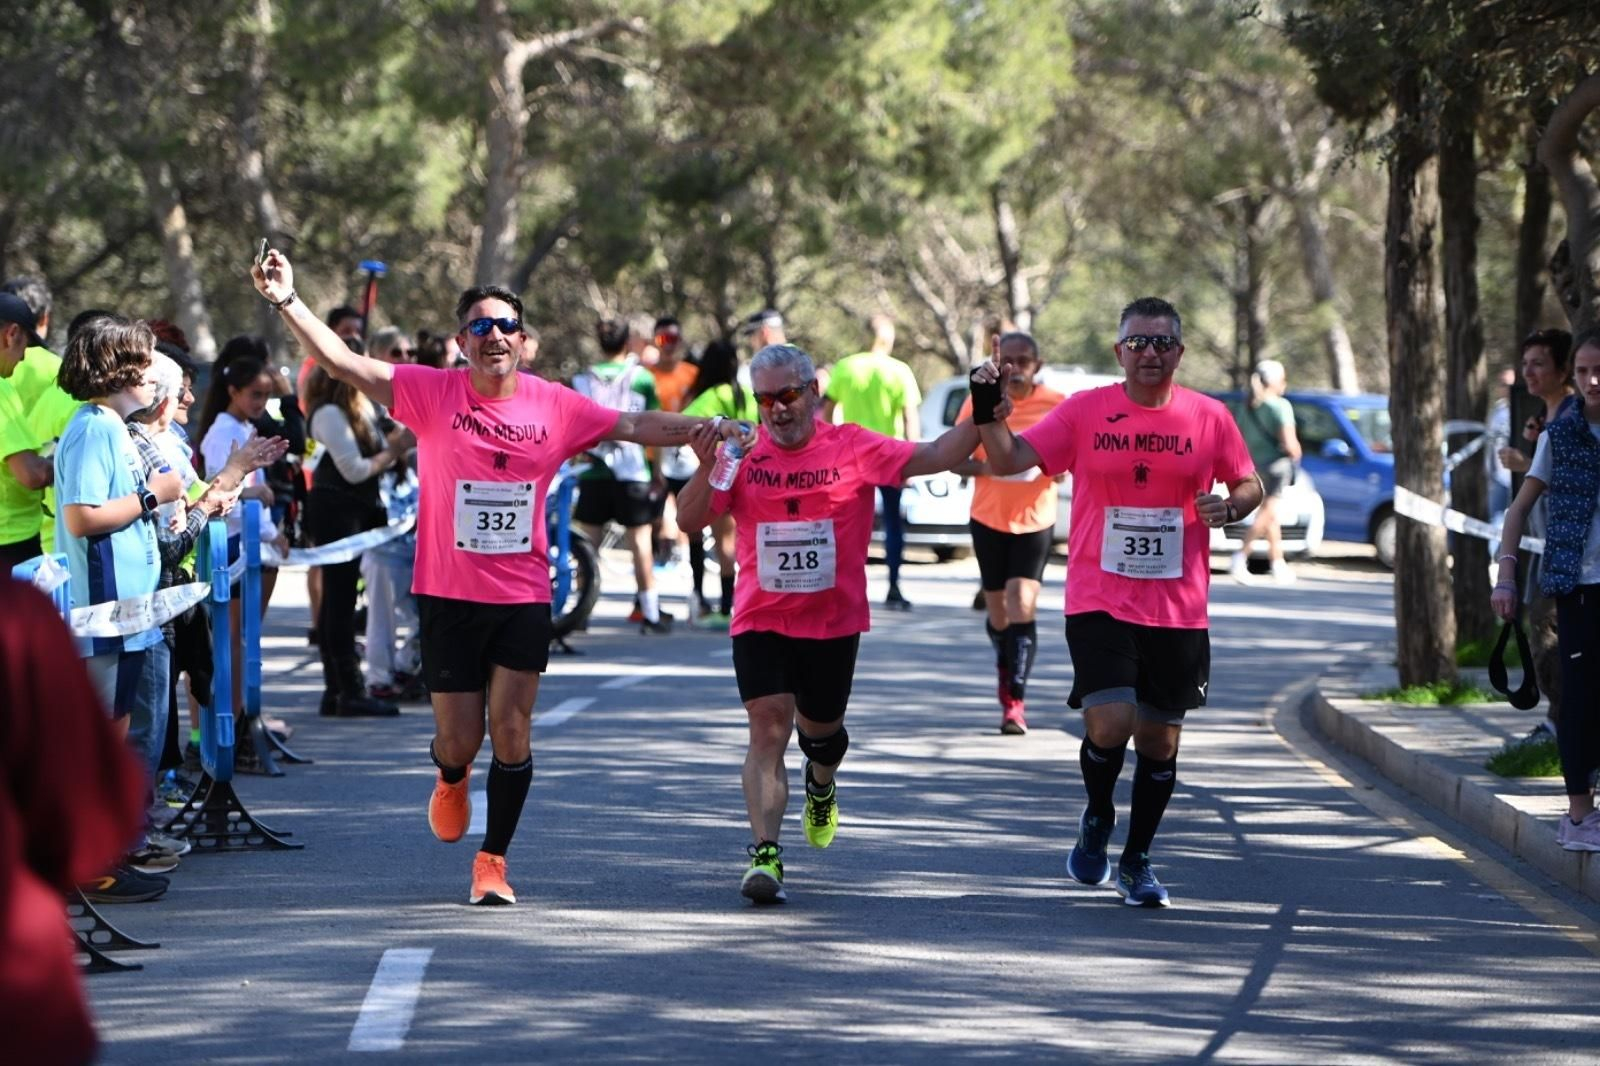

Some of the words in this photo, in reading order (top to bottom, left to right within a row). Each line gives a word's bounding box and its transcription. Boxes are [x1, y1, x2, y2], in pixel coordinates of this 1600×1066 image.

[452, 412, 490, 437] DONA
[1094, 432, 1130, 452] DONA
[746, 467, 782, 488] DONA
[476, 511, 517, 531] 332
[1122, 536, 1165, 556] 331
[778, 550, 820, 571] 218
